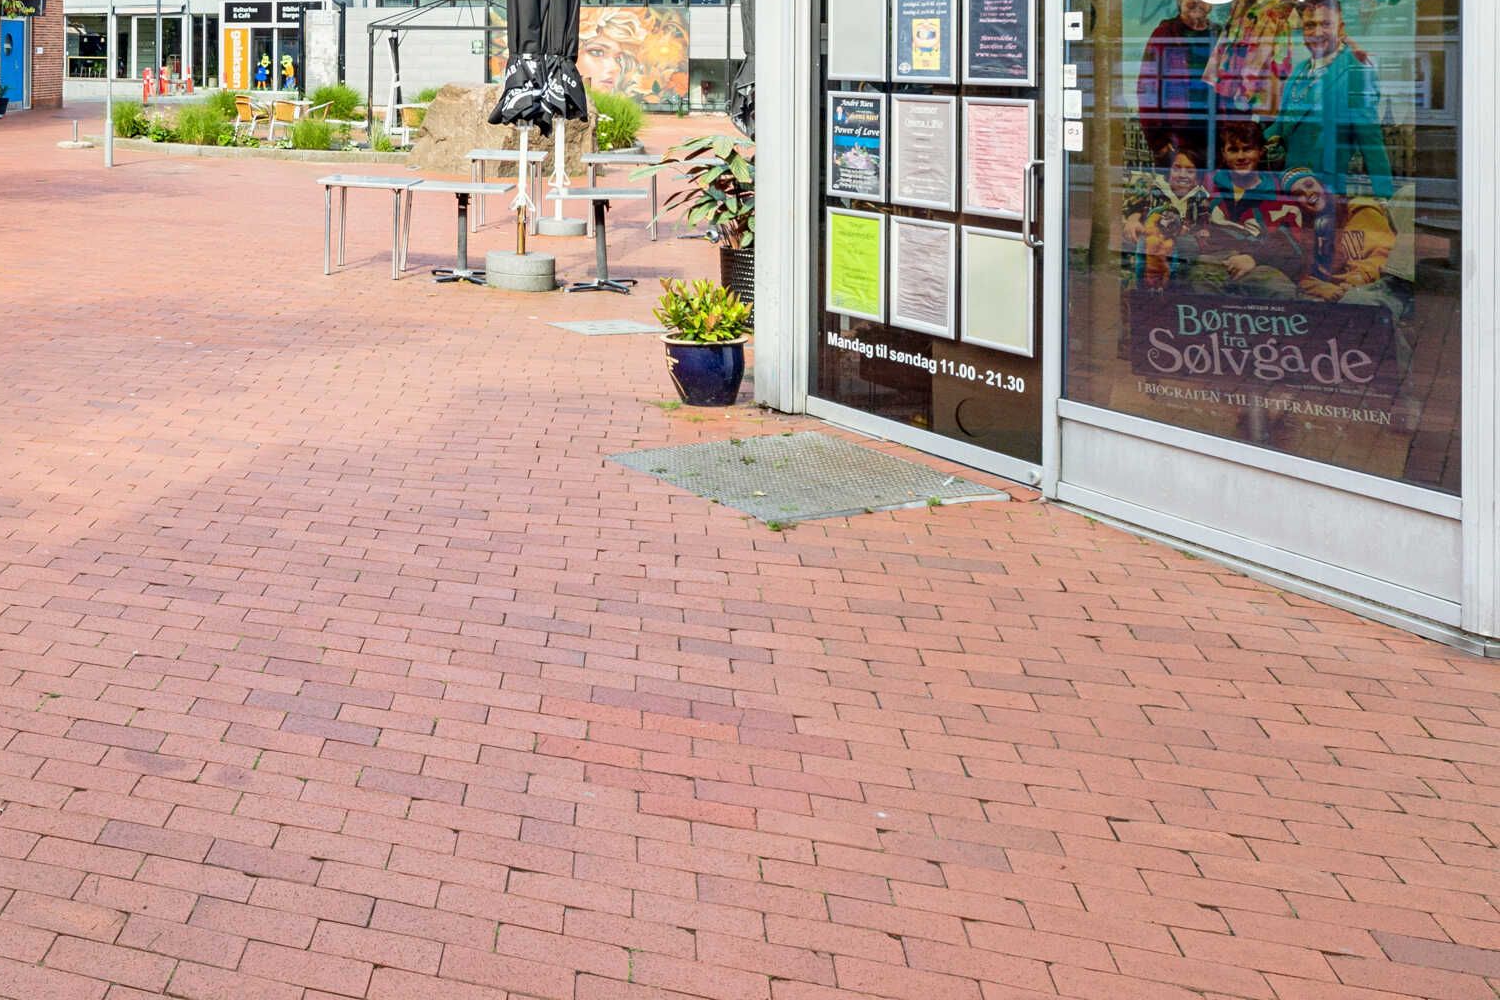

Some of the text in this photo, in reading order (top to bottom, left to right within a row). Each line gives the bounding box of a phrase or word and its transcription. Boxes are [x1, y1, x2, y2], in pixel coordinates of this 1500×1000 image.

[1175, 303, 1309, 337] Børnene
[1146, 327, 1375, 385] Sølvgade
[1222, 329, 1248, 349] fra
[827, 331, 873, 359] Mandag
[875, 344, 888, 359] til
[888, 348, 938, 374] søndag
[940, 359, 976, 381] 11.00
[985, 370, 1025, 393] 21.30
[1145, 382, 1221, 405] BIOGRAFEN
[1224, 392, 1251, 407] TIL
